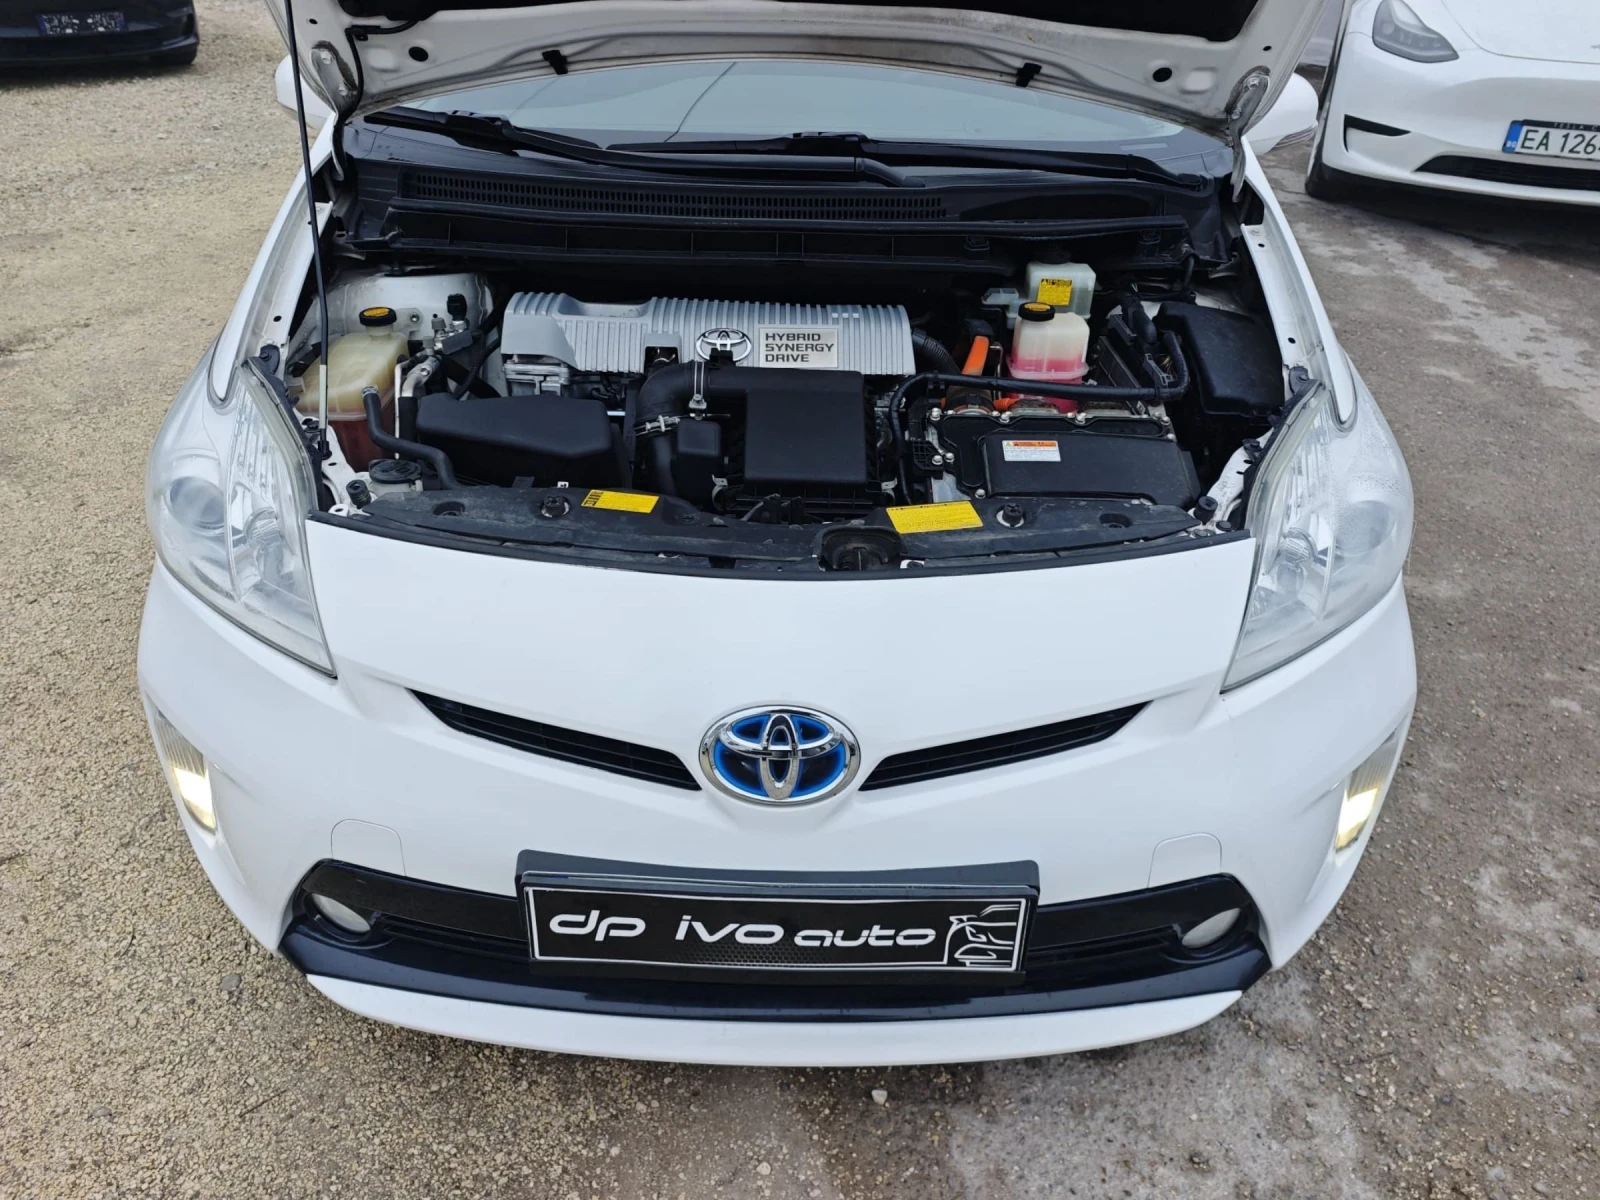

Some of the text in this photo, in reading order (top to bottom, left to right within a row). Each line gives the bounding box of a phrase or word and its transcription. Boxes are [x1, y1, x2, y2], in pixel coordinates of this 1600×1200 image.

[1520, 129, 1600, 155] EA 126
[765, 333, 821, 342] HYBRID
[765, 343, 834, 352] SYNERGY
[765, 354, 810, 363] DRIVE
[549, 909, 936, 947] dp ivo auto
